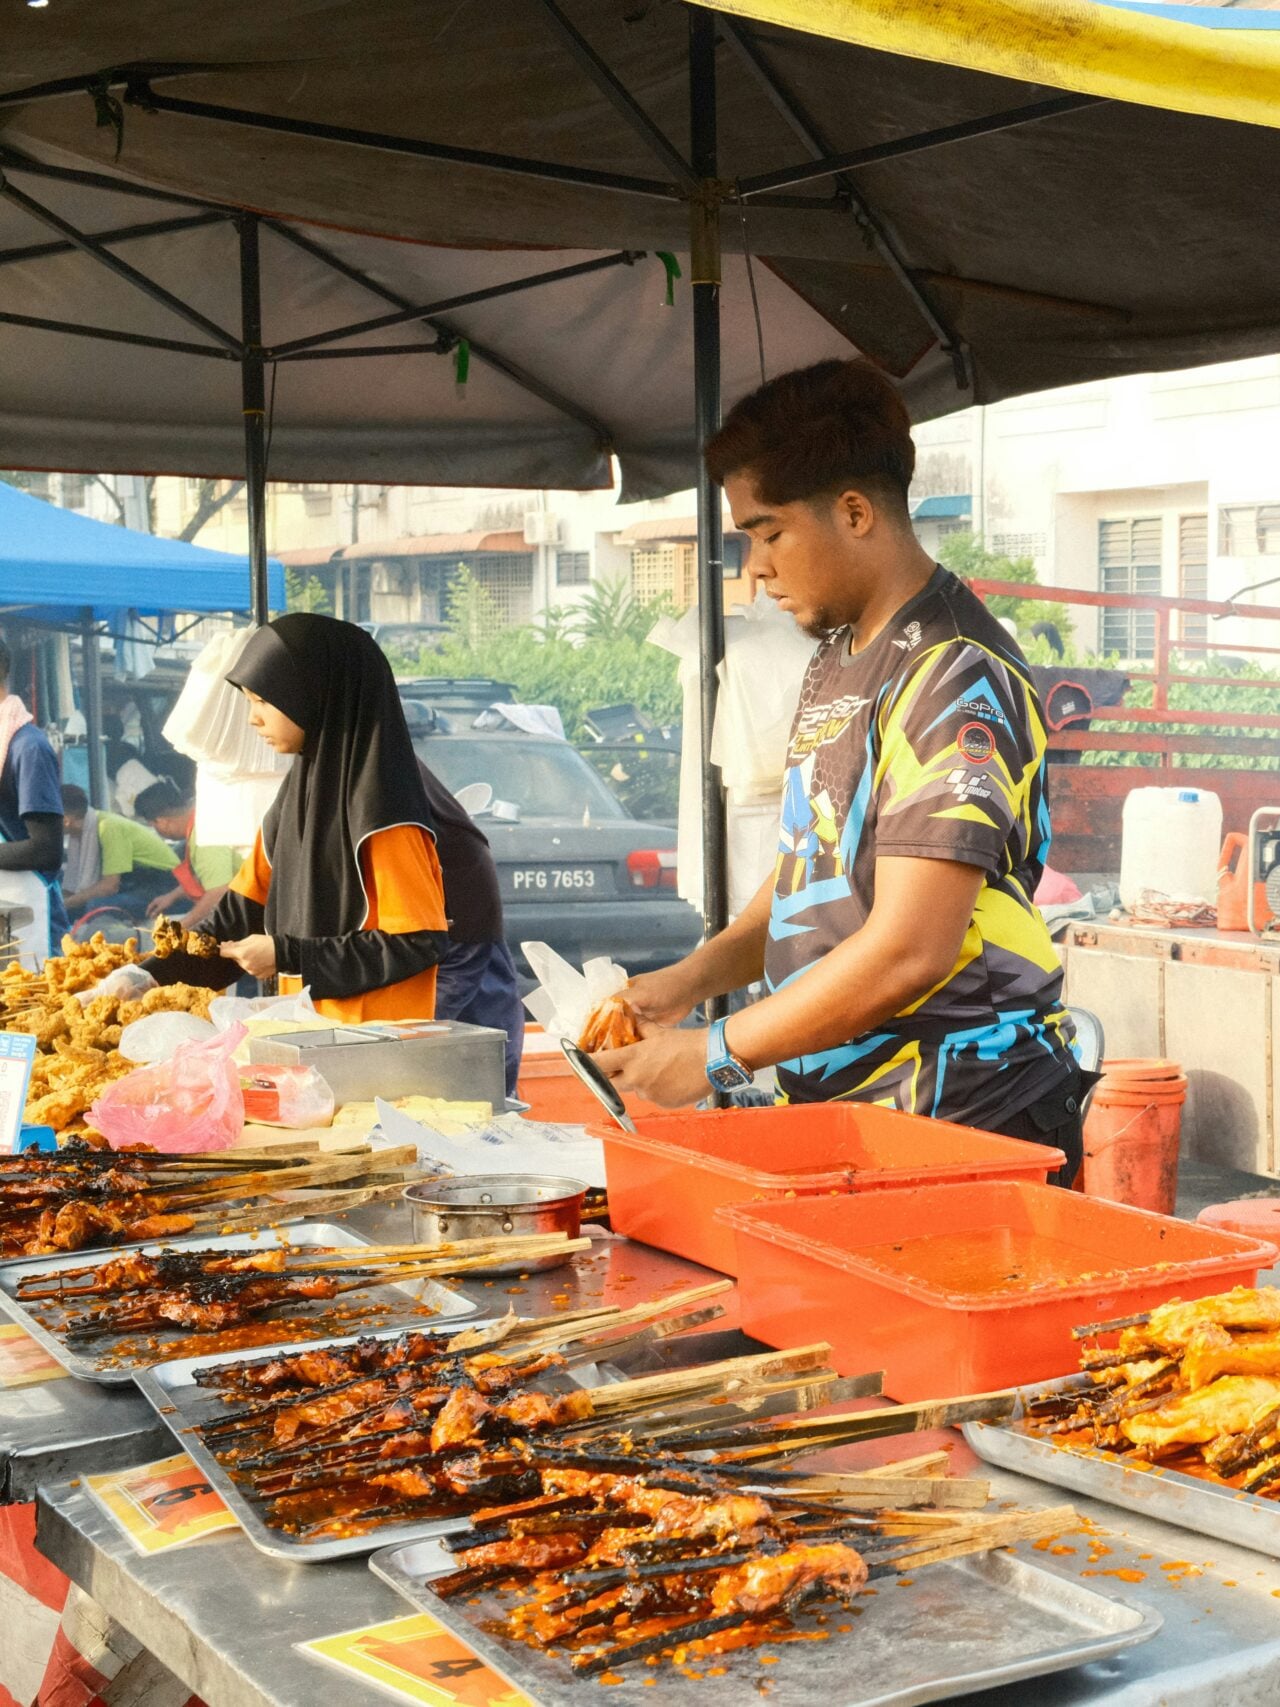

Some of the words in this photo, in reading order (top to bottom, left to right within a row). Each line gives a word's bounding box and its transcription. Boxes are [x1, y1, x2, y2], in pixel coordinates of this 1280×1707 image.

[956, 697, 1005, 718] GoPro
[513, 870, 547, 889] PFG
[551, 870, 595, 888] 7653
[430, 1657, 485, 1679] 4
